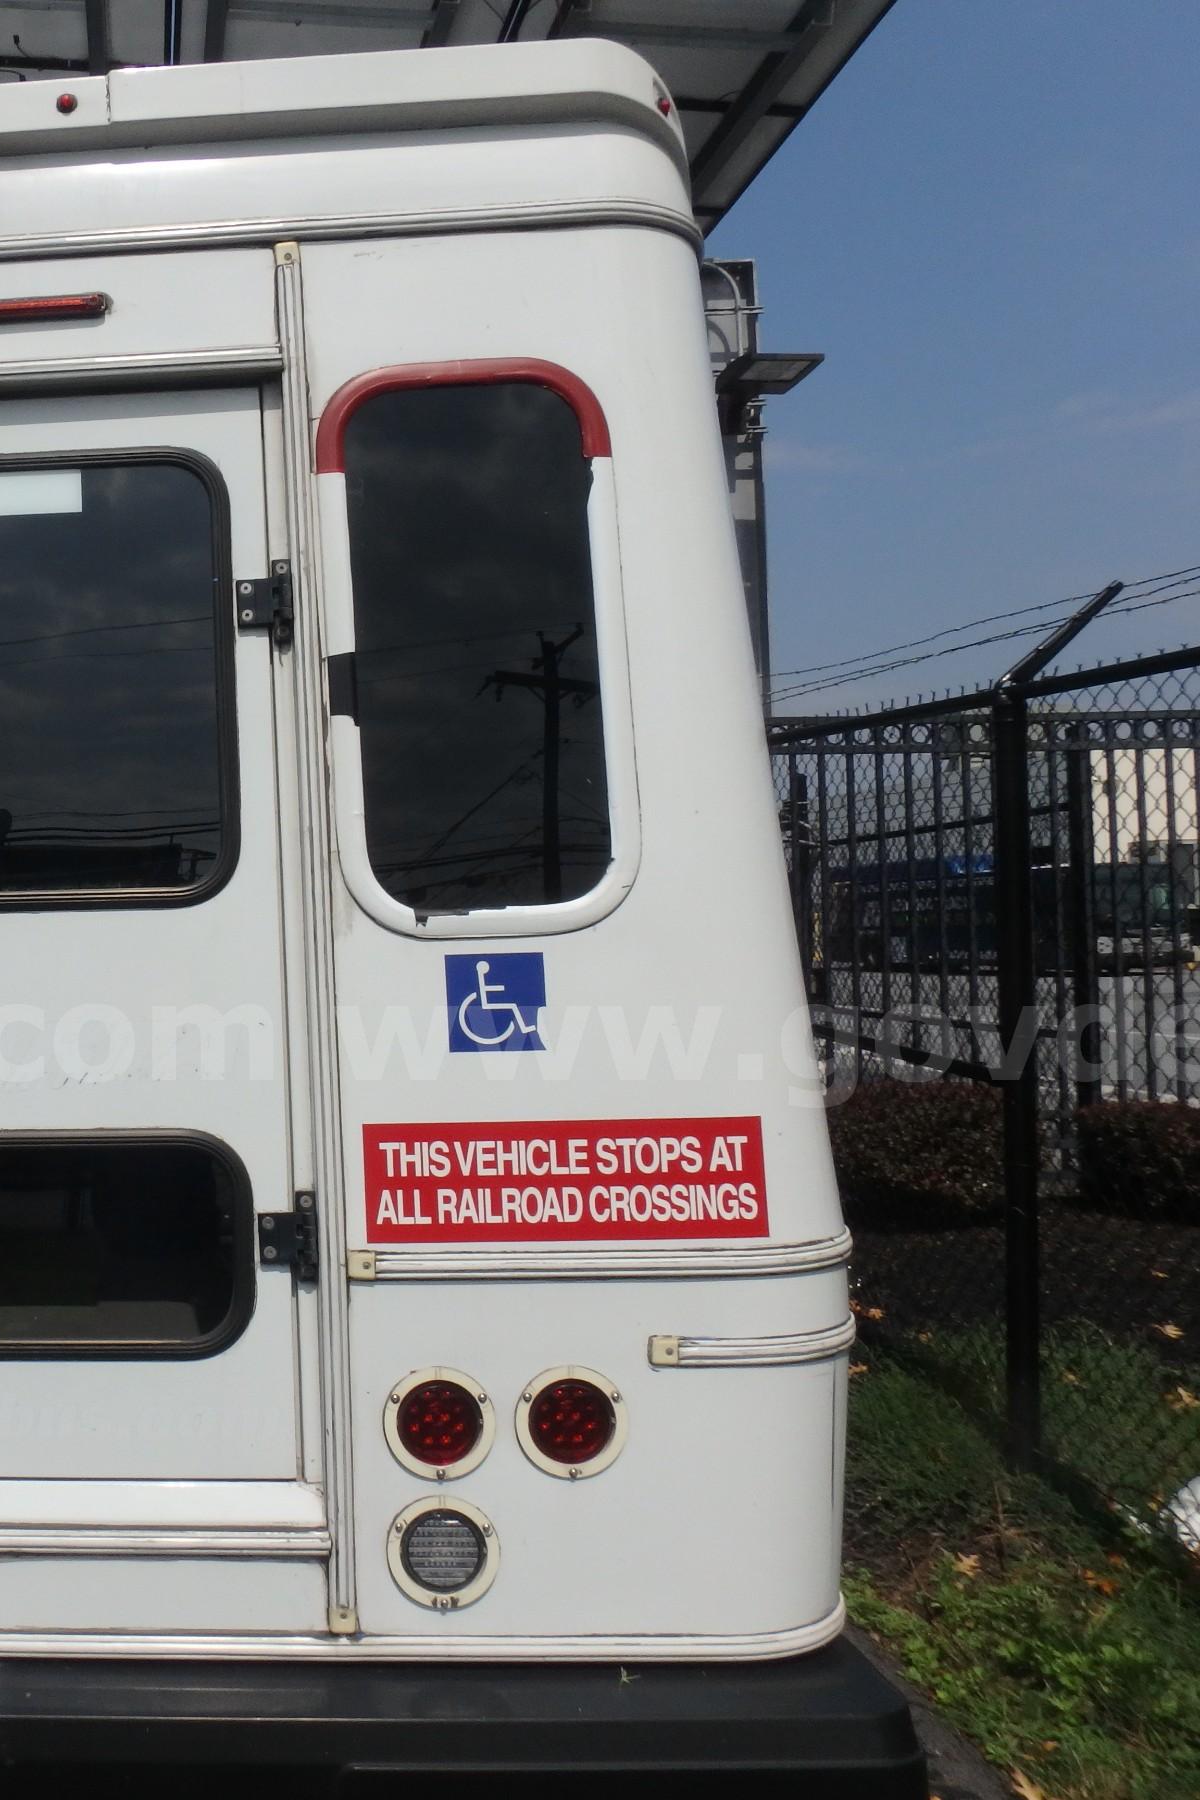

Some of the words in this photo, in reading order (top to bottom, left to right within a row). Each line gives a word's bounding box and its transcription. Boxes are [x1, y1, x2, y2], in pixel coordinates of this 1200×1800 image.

[379, 1141, 451, 1178] THIS
[454, 1138, 589, 1177] VEHICLE
[596, 1136, 703, 1176] STOPS
[709, 1135, 748, 1173] AT
[376, 1188, 432, 1226] ALL
[437, 1186, 583, 1225] RAILROAD
[588, 1182, 759, 1222] CROSSINGS
